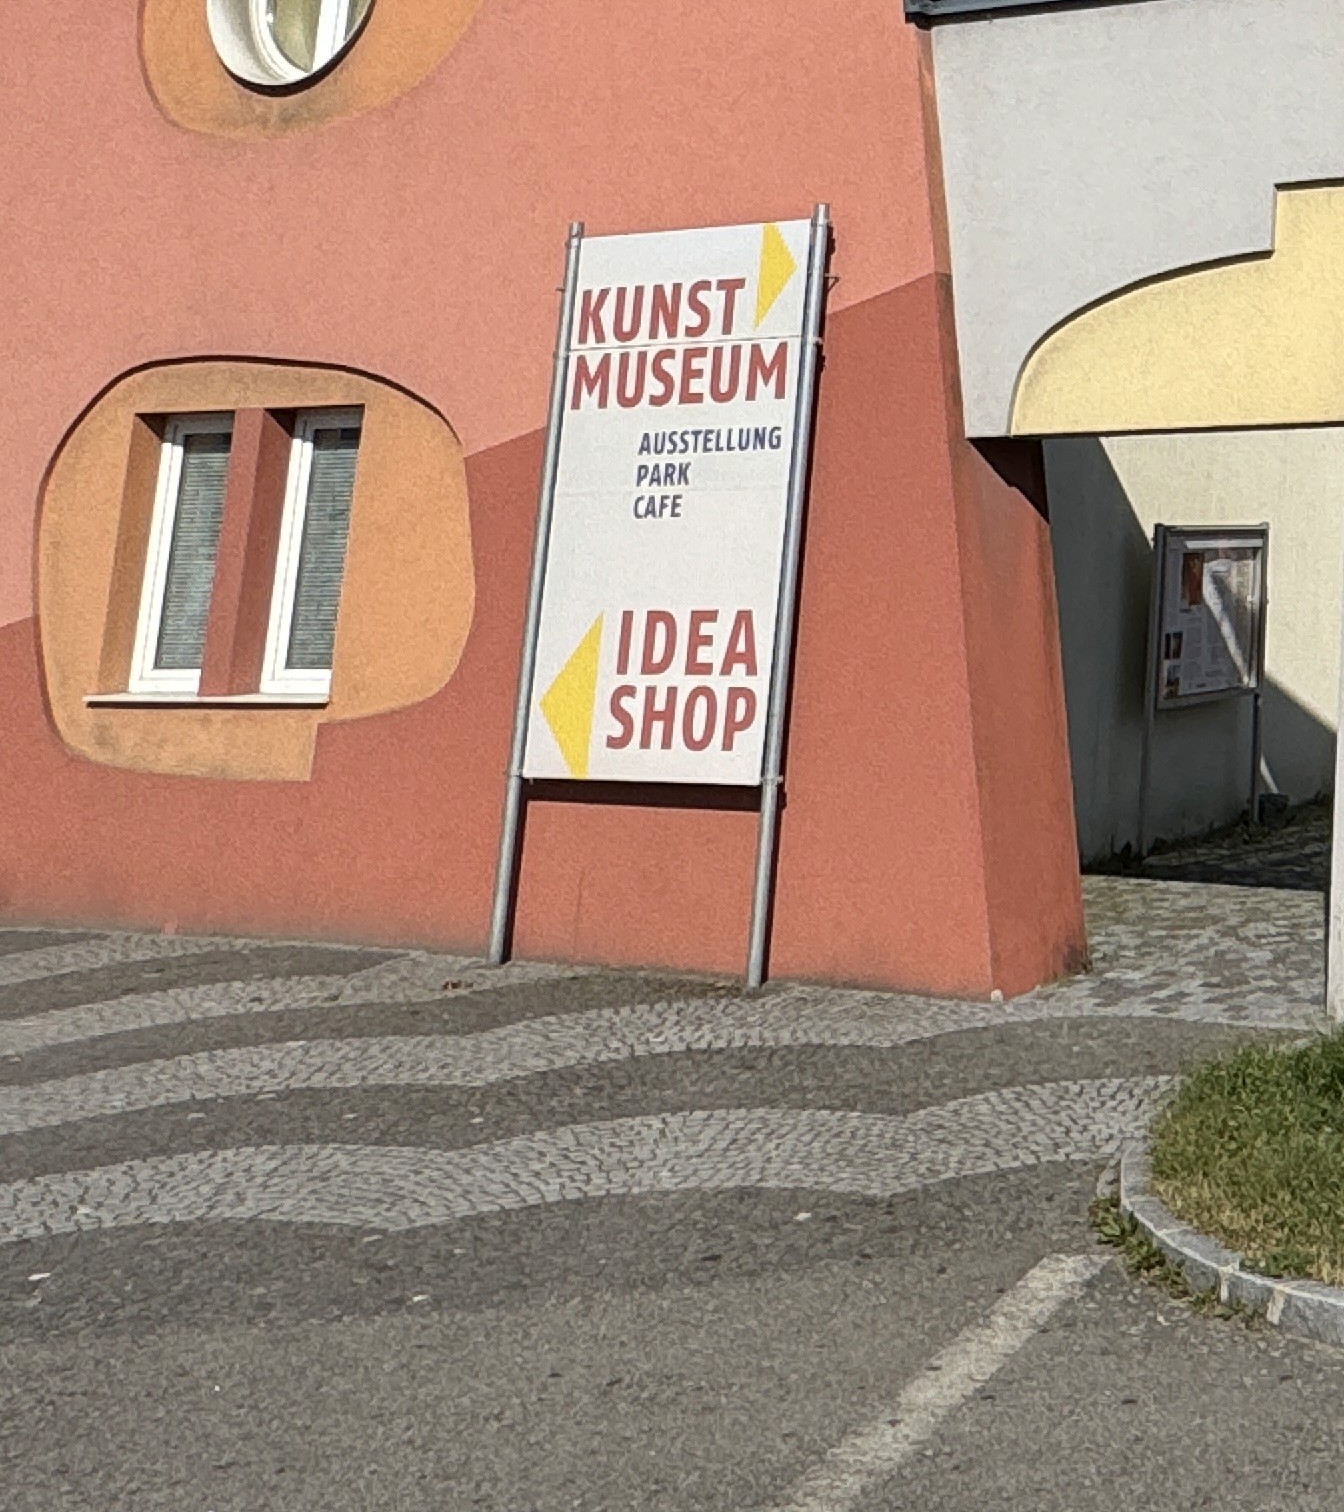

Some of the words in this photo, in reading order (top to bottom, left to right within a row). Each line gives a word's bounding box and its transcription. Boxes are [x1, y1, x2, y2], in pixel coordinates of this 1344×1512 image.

[577, 278, 747, 345] KUNST
[570, 342, 789, 410] MUSEUM
[635, 461, 691, 487] PARK
[637, 425, 782, 456] AUSSTELLUNG
[632, 494, 683, 520] CAFE
[615, 608, 758, 677] IDEA
[605, 685, 757, 752] SHOP
